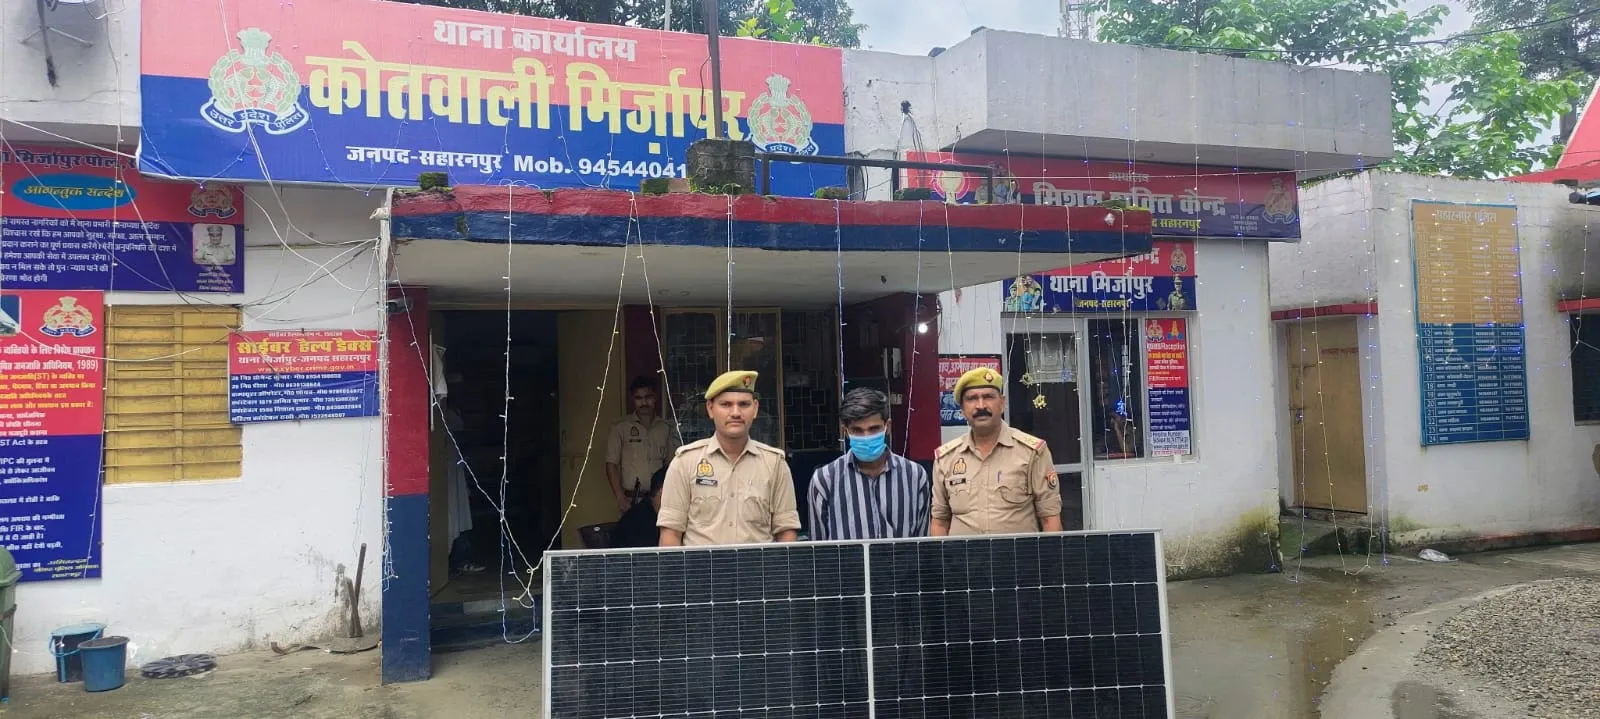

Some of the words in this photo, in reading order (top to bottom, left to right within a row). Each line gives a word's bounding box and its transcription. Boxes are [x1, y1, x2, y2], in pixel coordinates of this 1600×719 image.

[434, 19, 504, 49] थाना
[512, 24, 637, 62] कार्यालय
[306, 41, 555, 130] कोतवाली
[566, 62, 746, 154] मिर्ज़ापर
[345, 145, 502, 174] जनपद-सहारनपुर
[514, 155, 570, 174] Mob.
[579, 159, 686, 179] 94544041
[86, 186, 125, 199] सन्देश
[1033, 181, 1104, 206] मिशन
[1178, 188, 1227, 216] केन्द्र
[1159, 219, 1200, 231] सहारनपुर
[1050, 275, 1089, 293] थाना
[236, 337, 291, 355] साईबर
[76, 359, 98, 371] 1989)
[10, 524, 24, 532] FIR
